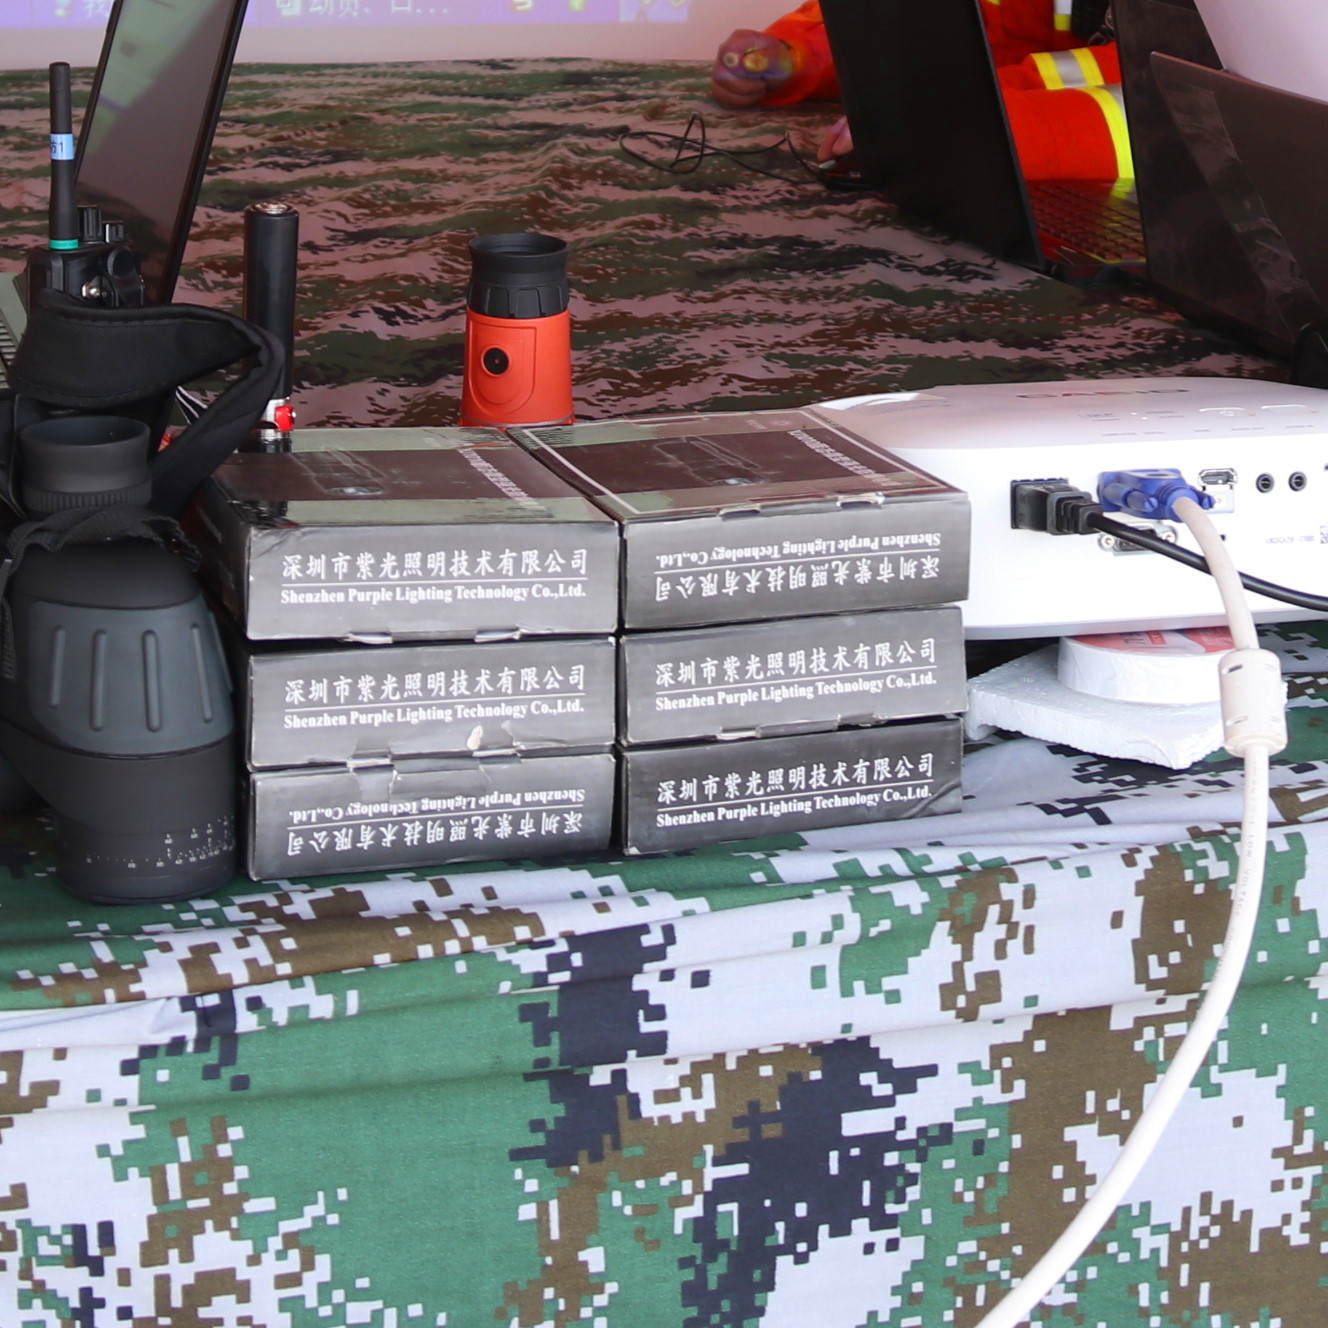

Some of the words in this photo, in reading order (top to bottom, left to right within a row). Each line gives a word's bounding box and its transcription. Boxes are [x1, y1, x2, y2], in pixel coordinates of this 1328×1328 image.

[782, 538, 835, 555] Lighting
[836, 534, 880, 552] Purple
[882, 532, 942, 546] Shenzhen
[281, 548, 588, 581] 深圳市紫光照明技术有限公司
[712, 544, 780, 562] Technology
[654, 554, 941, 603] 深圳市紫光照明技术有限公司
[280, 588, 346, 604] Shenzhen
[348, 587, 393, 606] Purple
[395, 586, 453, 604] Lighting
[454, 584, 529, 602] Technology
[655, 637, 936, 688] 深圳市紫光照明技术有限公司
[284, 664, 586, 705] 深圳市紫光照明技术有限公司
[656, 694, 715, 712] Shenzhen
[716, 690, 759, 708] Purple
[760, 684, 814, 702] Lighting
[816, 677, 884, 696] Technology
[284, 712, 347, 729] Shenzhen
[350, 710, 394, 728] Purple
[396, 706, 453, 724] Lighting
[454, 702, 528, 720] Technology
[657, 752, 934, 805] 深圳市紫光照明技术有限公司
[421, 795, 478, 812] Lighting
[478, 792, 522, 808] Purple
[524, 788, 585, 803] Shenzhen
[346, 800, 418, 818] Technology
[656, 811, 716, 828] Shenzhen
[717, 806, 758, 822] Purple
[760, 800, 812, 817] Lighting
[814, 792, 881, 810] Technology
[286, 810, 584, 857] 深圳市紫光照明技术有限公司
